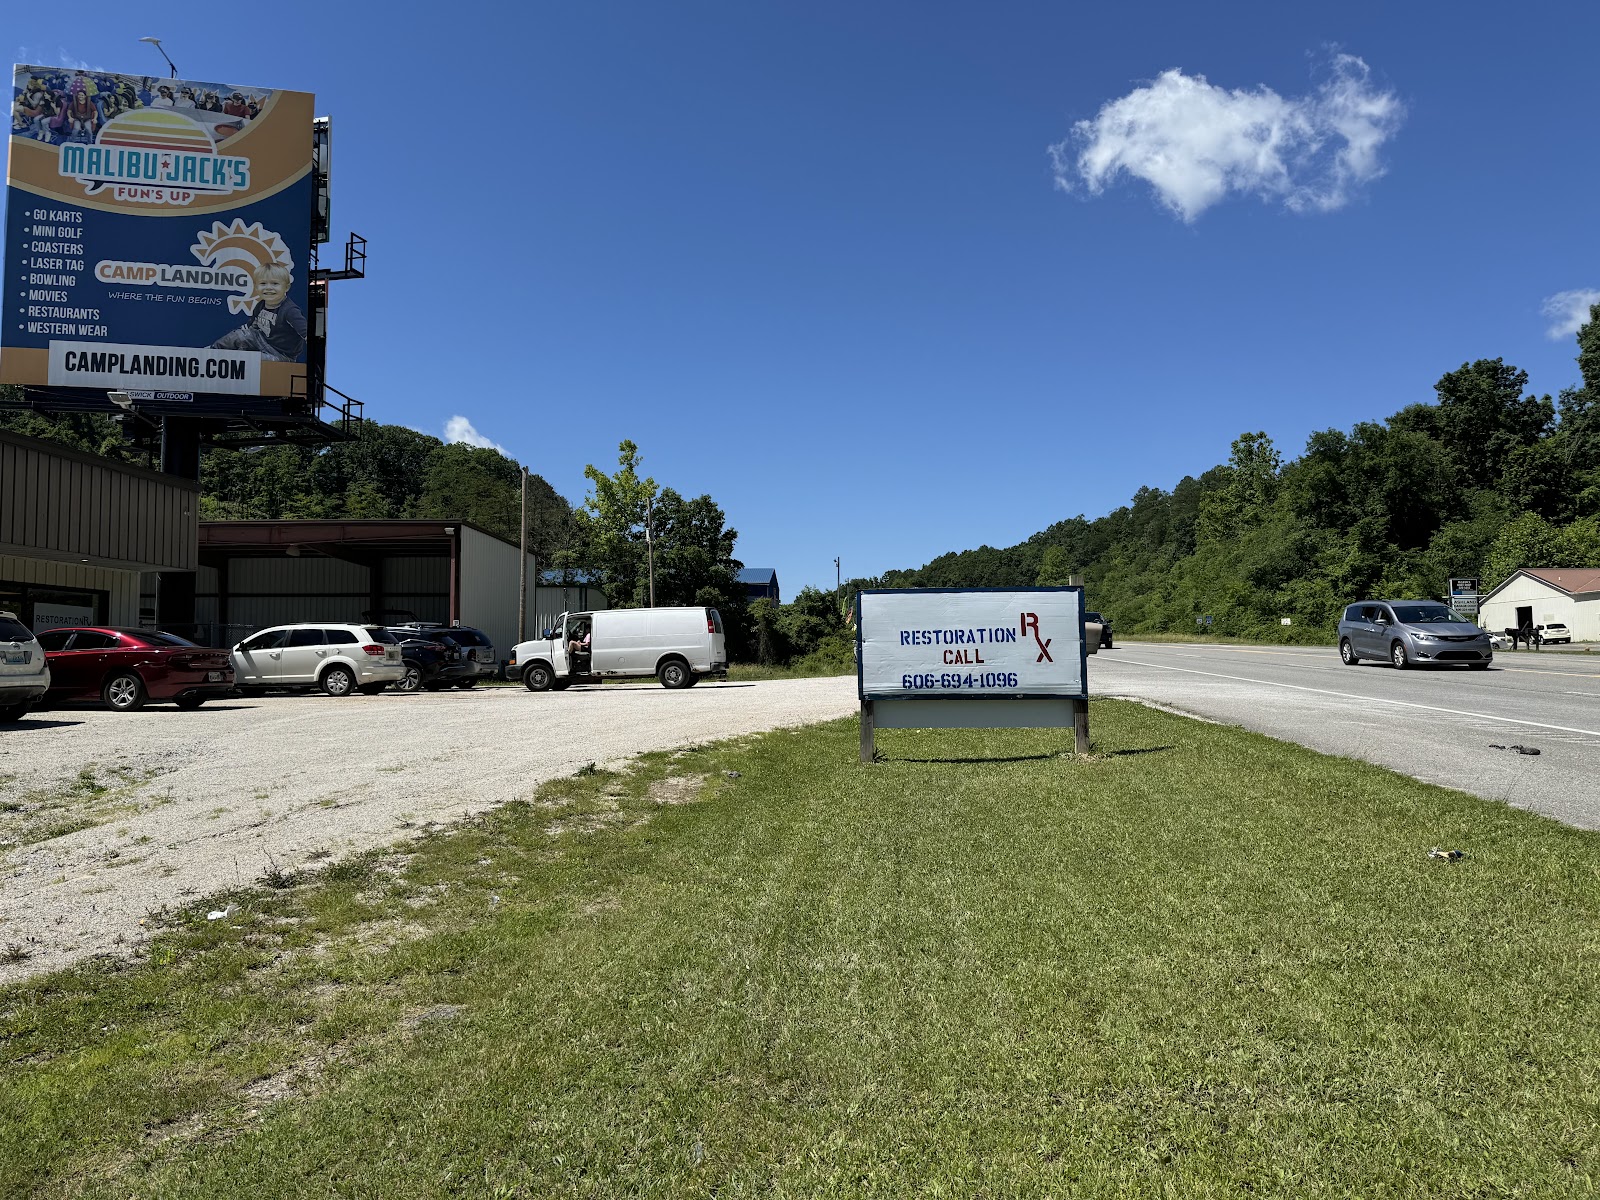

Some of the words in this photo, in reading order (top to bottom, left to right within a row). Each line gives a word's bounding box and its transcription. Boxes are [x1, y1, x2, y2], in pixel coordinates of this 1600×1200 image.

[62, 146, 158, 180] MALIBU
[166, 155, 247, 187] JACK'S
[118, 187, 163, 200] FUN'S
[170, 191, 191, 201] UP
[33, 209, 47, 220] GO
[49, 210, 83, 222] KARTS
[32, 225, 55, 237] MINI
[58, 227, 83, 239] GOLF
[31, 241, 84, 255] COASTERS
[30, 257, 63, 270] LASER
[65, 259, 85, 271] TAG
[30, 273, 76, 287] BOWLING
[99, 264, 157, 281] CAMP
[161, 268, 248, 287] LANDING
[29, 289, 68, 302] MOVIES
[108, 291, 142, 301] WHERE
[145, 293, 164, 302] THE
[166, 294, 185, 303] FUN
[188, 296, 222, 306] BEGINS
[28, 305, 100, 320] RESTAURANTS
[27, 322, 76, 335] WESTERN
[78, 324, 108, 337] WEAR
[65, 351, 246, 380] CAMPLANDING.COM
[156, 392, 189, 400] OUTDOOR
[35, 614, 84, 626] RESTORATION
[900, 627, 1016, 646] RESTORATION
[943, 649, 985, 664] CALL
[902, 672, 1018, 689] 606-694-1096
